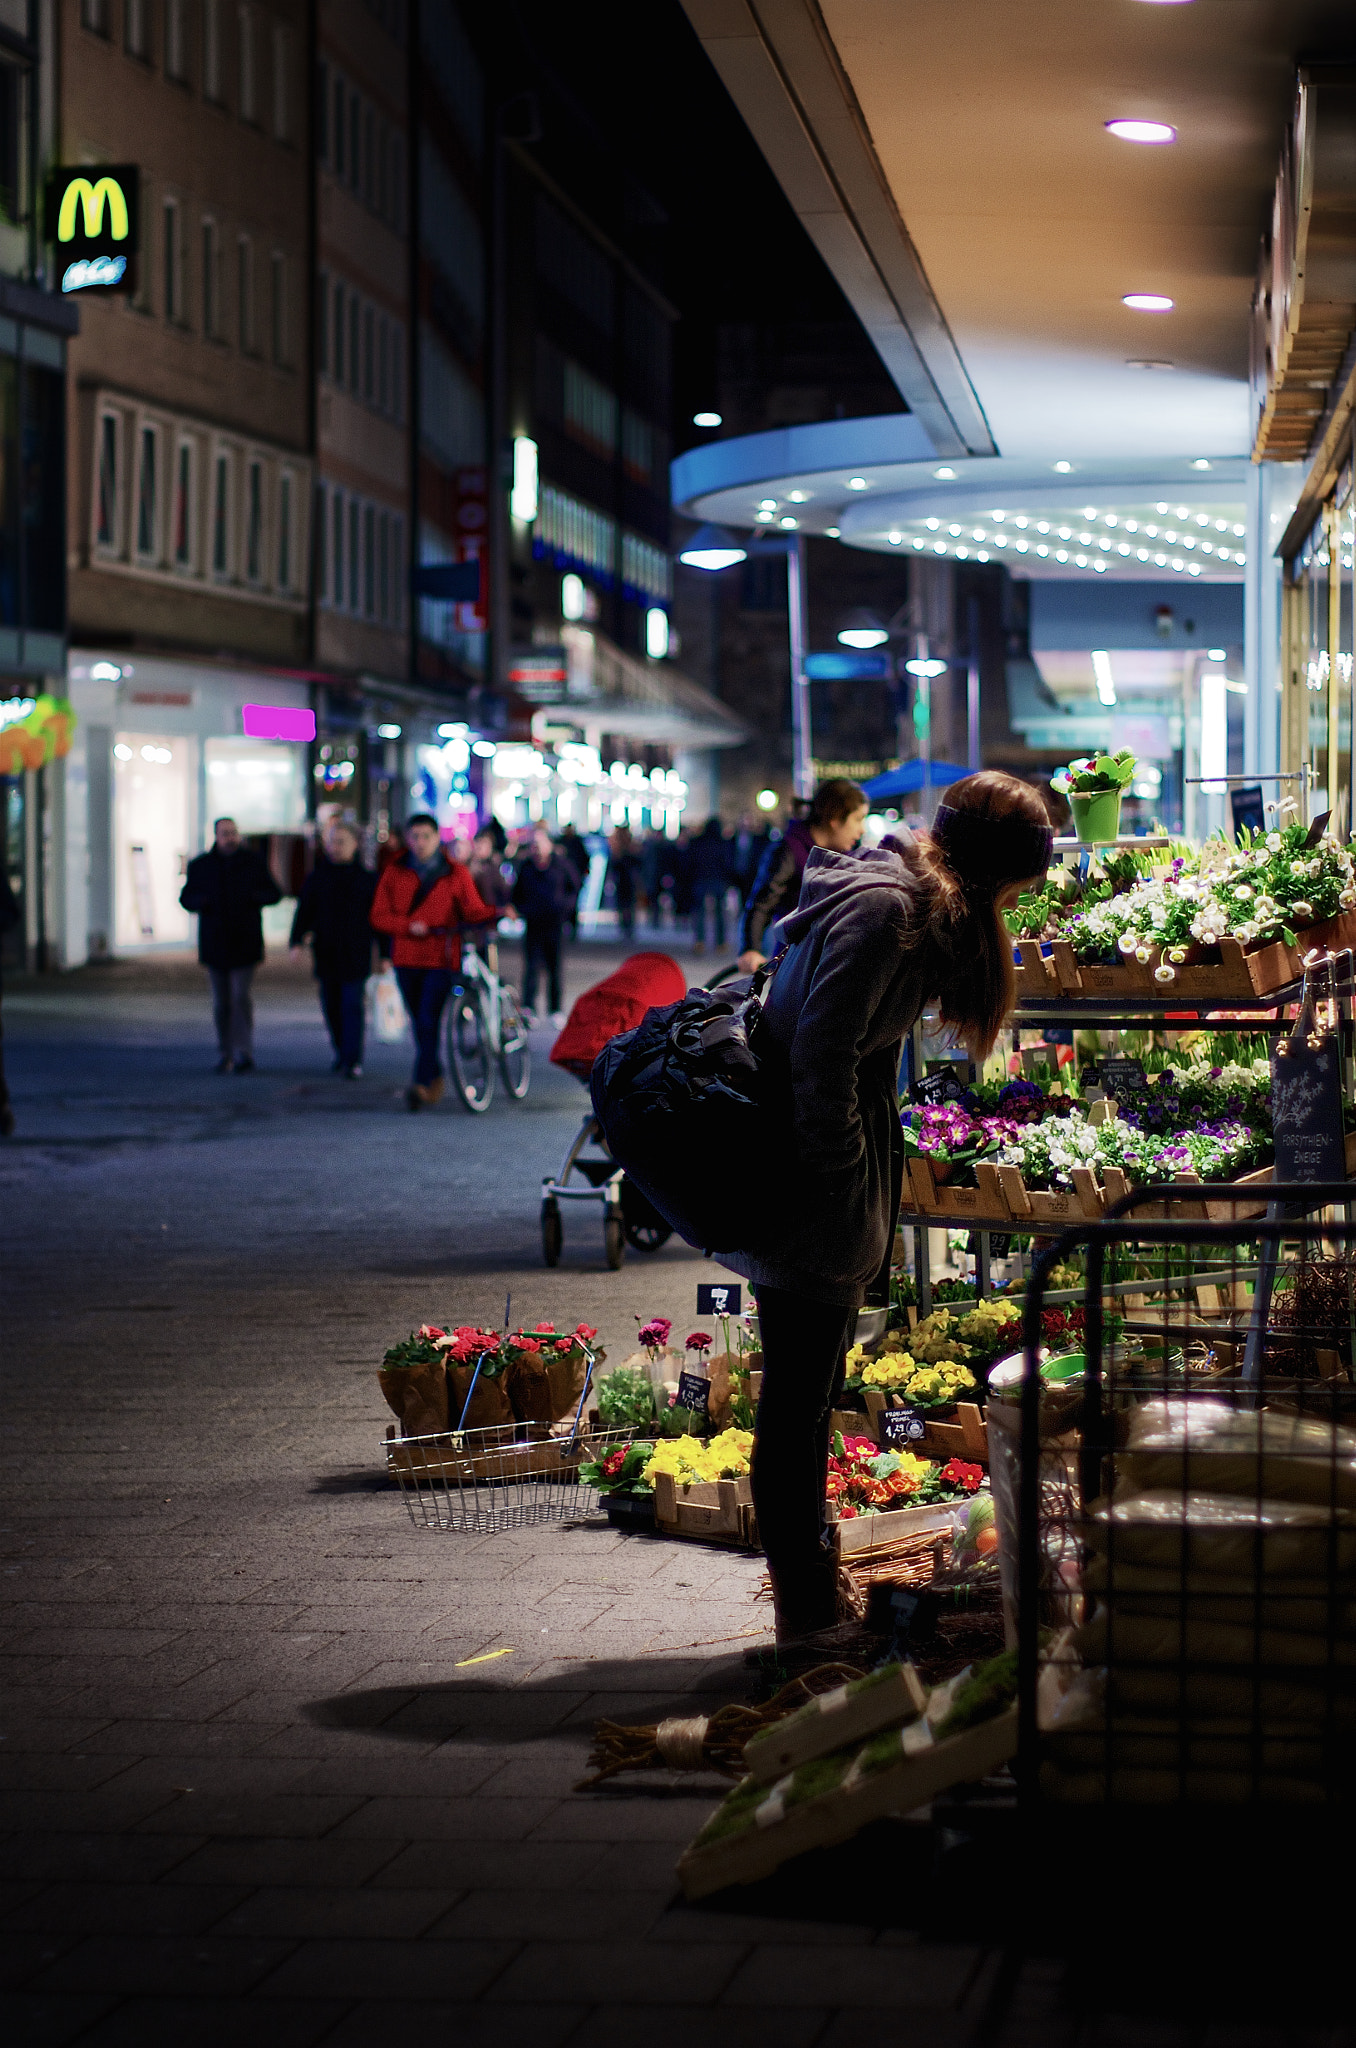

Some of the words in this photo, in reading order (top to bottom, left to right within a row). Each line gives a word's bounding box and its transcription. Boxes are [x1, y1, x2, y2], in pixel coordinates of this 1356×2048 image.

[457, 472, 487, 629] HOTL
[1293, 1150, 1322, 1164] ZWEIGE
[885, 1424, 905, 1439] 1,29
